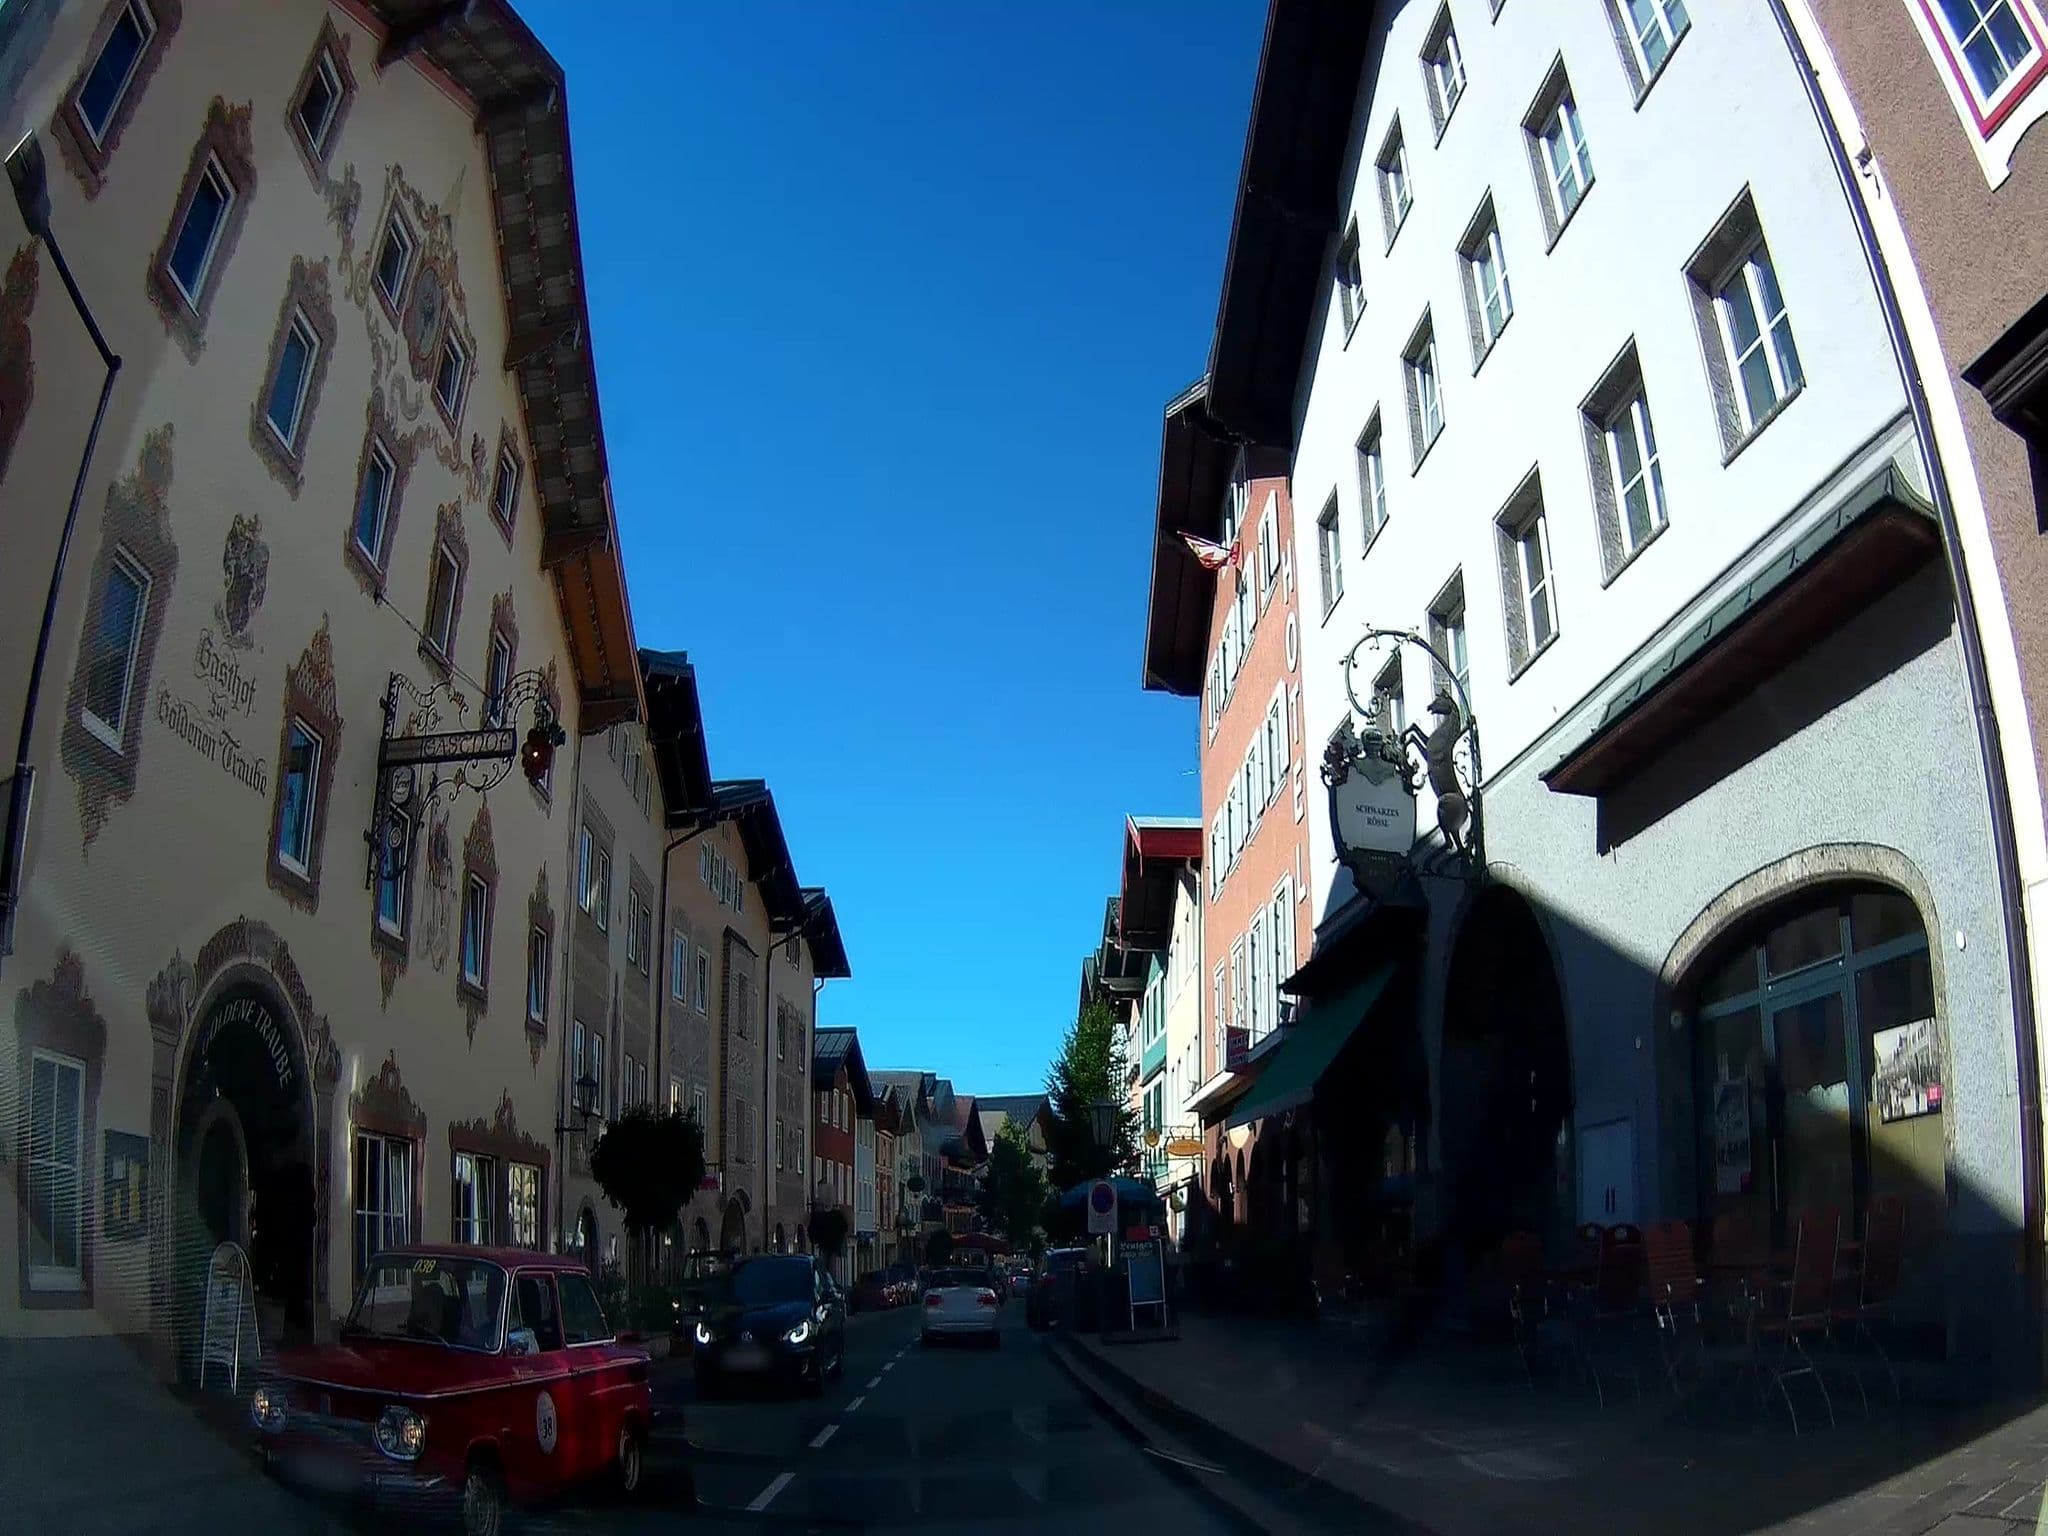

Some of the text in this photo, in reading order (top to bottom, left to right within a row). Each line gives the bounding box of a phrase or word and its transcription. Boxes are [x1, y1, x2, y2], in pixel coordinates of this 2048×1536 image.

[195, 632, 256, 720] Gasthof
[158, 684, 268, 798] Goldenen Traube
[1281, 538, 1307, 904] HOTEL
[254, 1004, 296, 1089] TRAUBE
[541, 1416, 553, 1439] 38
